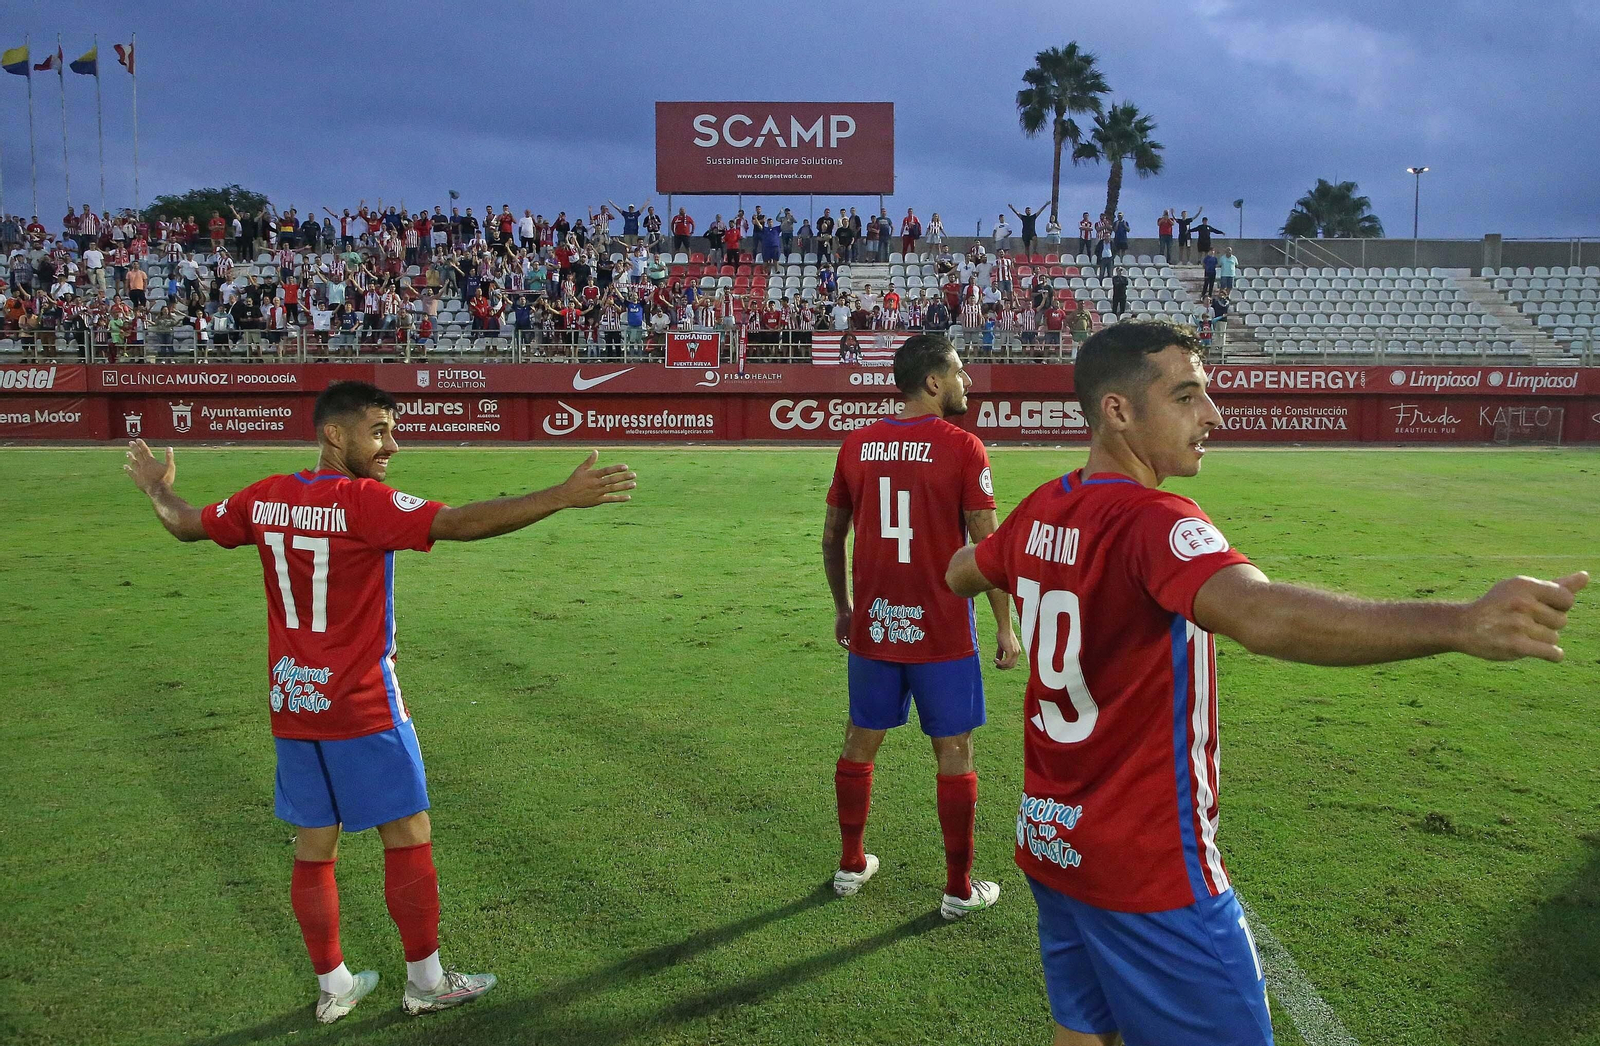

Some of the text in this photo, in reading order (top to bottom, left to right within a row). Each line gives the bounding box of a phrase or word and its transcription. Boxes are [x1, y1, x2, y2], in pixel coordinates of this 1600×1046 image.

[692, 114, 857, 148] SCAMP
[706, 156, 843, 167] Sustainable Shipcare Solutions
[737, 172, 813, 180] www.scampnetwork.com
[237, 372, 297, 384] PODOLOGÍA
[437, 367, 487, 380] FÚTBOL
[849, 372, 897, 386] OBRA
[1216, 369, 1359, 389] CAPENERGY
[1409, 370, 1482, 392] Limpiasol
[1506, 371, 1579, 393] Limpiasol
[437, 381, 487, 389] COALITION
[34, 409, 81, 423] Motor
[201, 406, 292, 419] Ayuntamiento
[587, 409, 714, 431] Expressreformas
[976, 401, 1090, 428] ALGES
[1216, 405, 1348, 415] Materiales de Construcción
[1389, 402, 1461, 426] Frida
[209, 418, 285, 434] de Algeciras
[394, 420, 501, 432] ORTE ALGECIREÑO
[1214, 416, 1348, 430] AGUA MARINA
[860, 441, 933, 463] BORJA FDEZ.
[252, 500, 348, 533] DAVID MARTÍN
[879, 476, 914, 564] 4
[263, 531, 330, 633] 17
[888, 620, 926, 644] Gusta
[1016, 576, 1099, 744] 19
[272, 655, 334, 693] Algeiras
[288, 685, 332, 714] Gusta
[1020, 792, 1083, 830] eciras
[1026, 823, 1082, 869] Gusta
